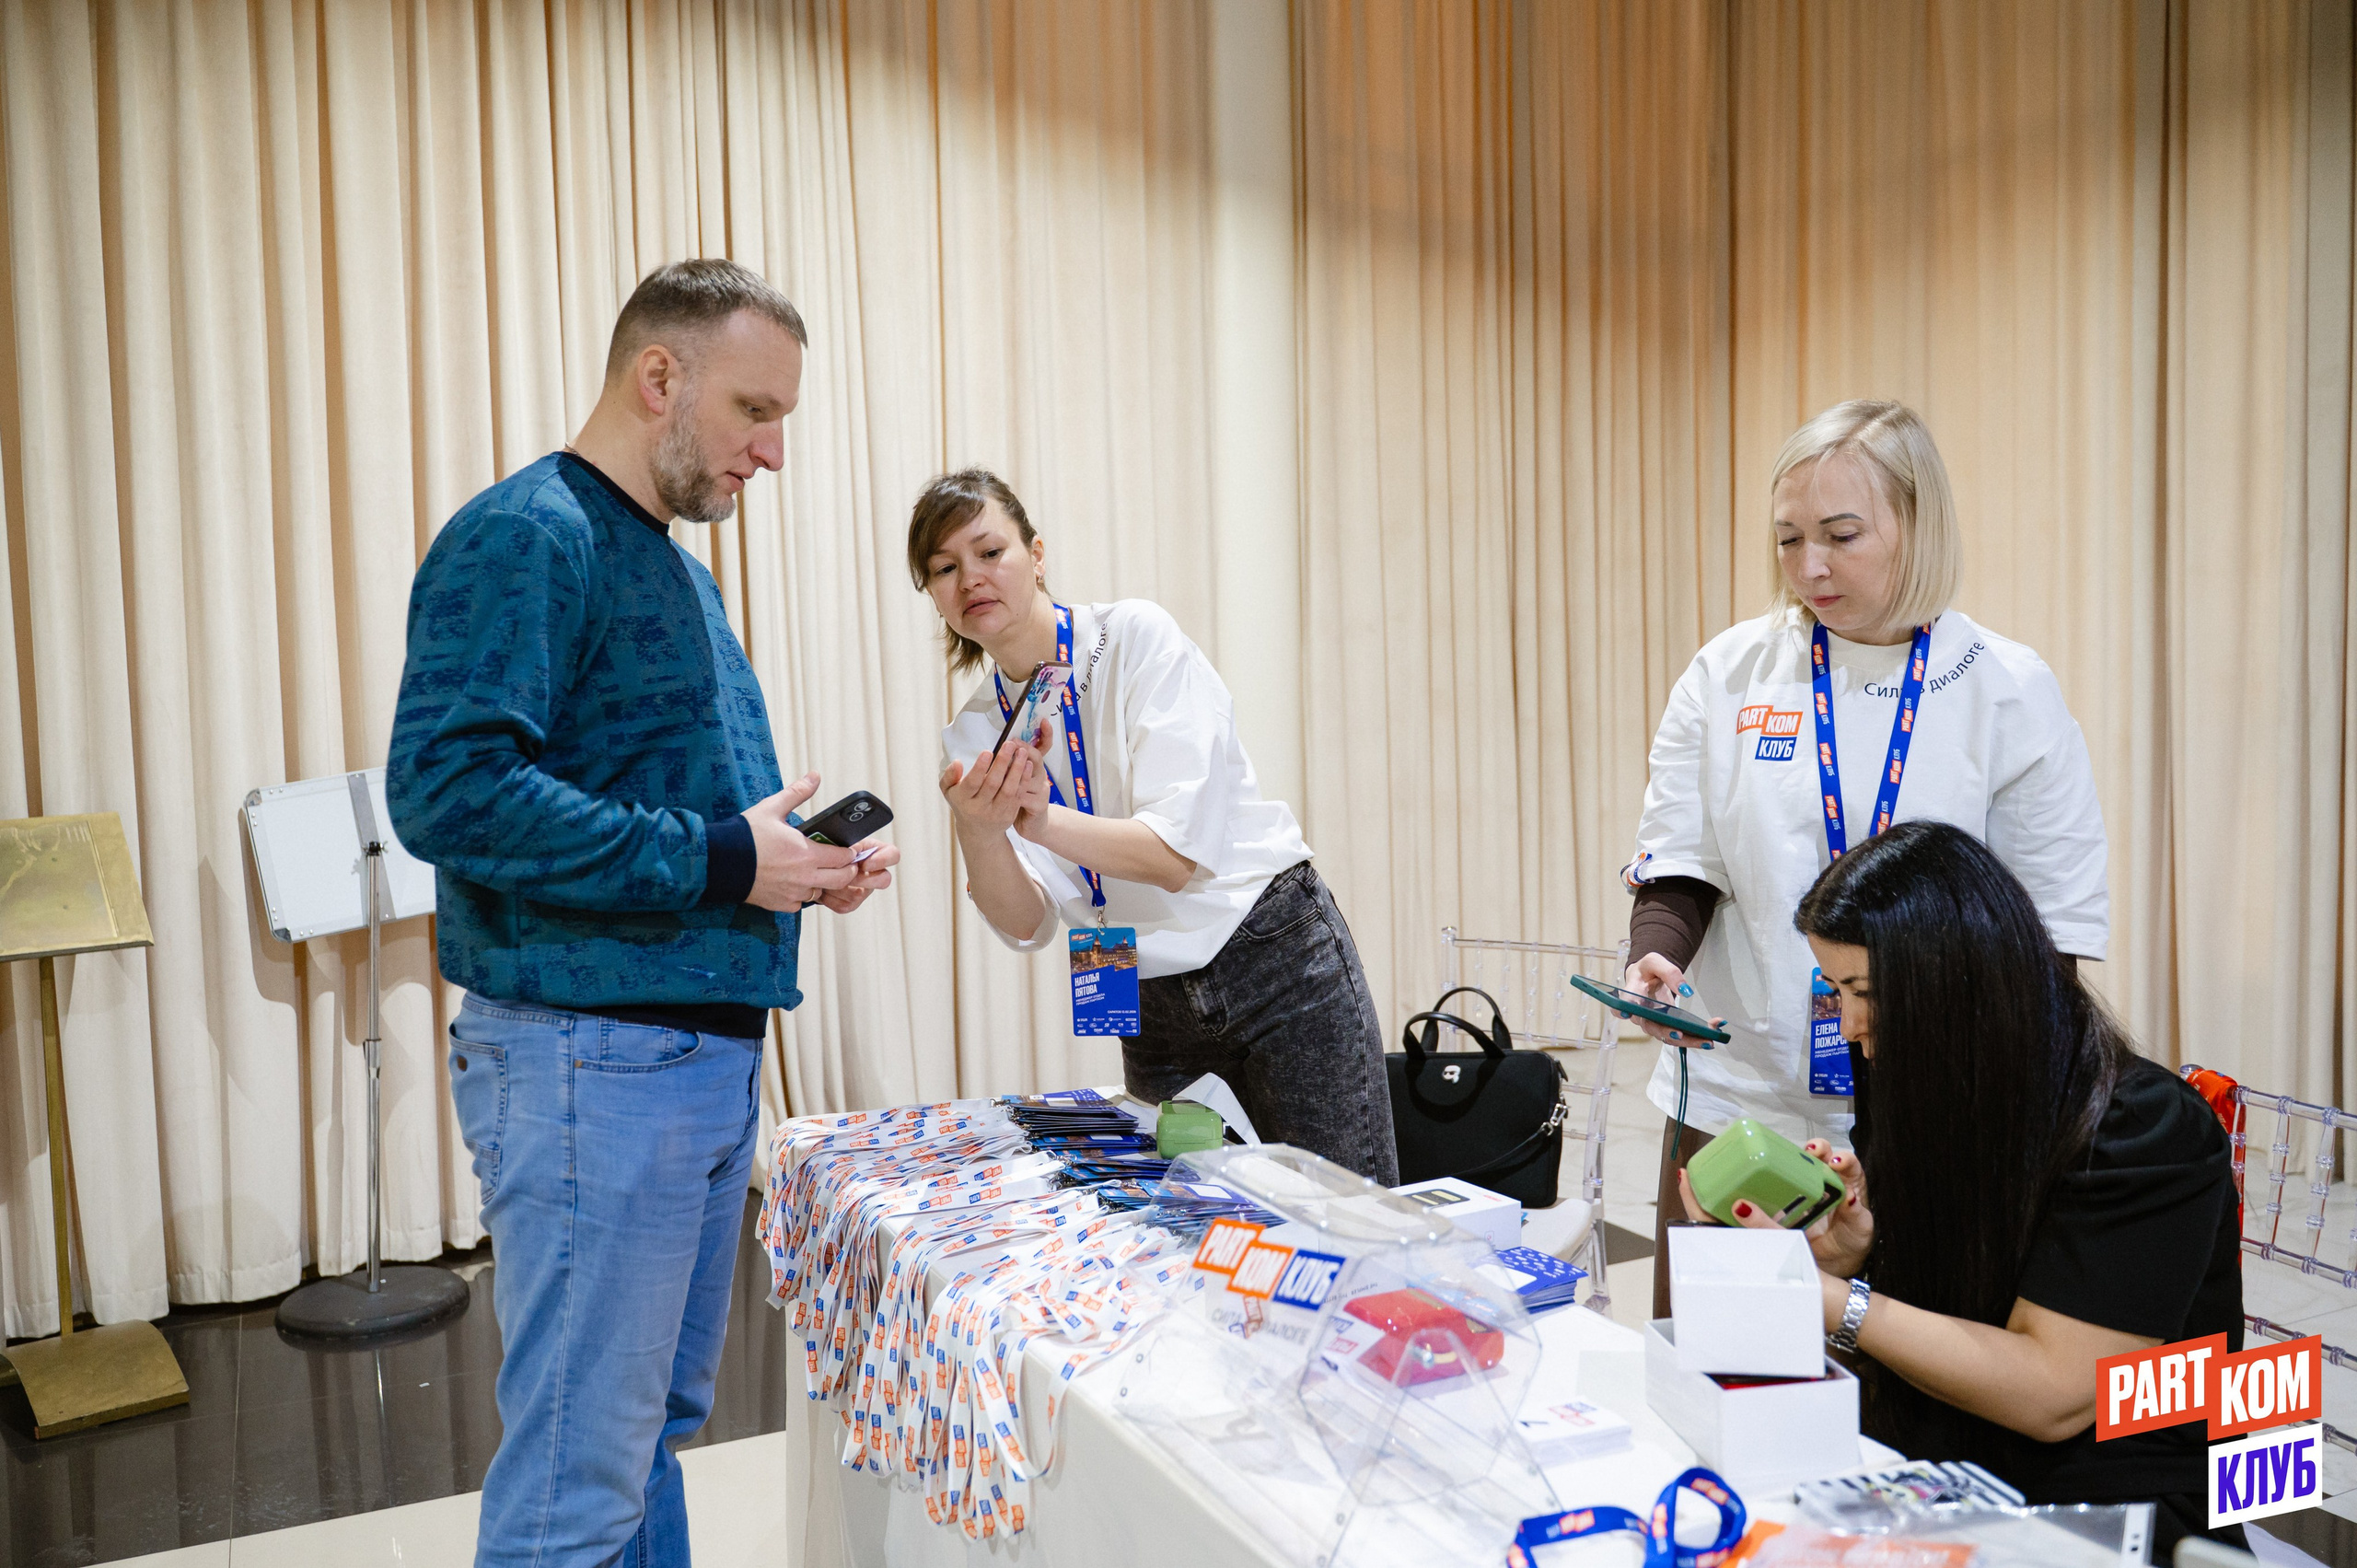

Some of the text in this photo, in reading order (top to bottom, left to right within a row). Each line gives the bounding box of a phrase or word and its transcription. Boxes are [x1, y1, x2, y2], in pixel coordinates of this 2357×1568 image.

[1864, 682, 1902, 698] Сил
[1929, 642, 1985, 693] диалоге
[1738, 707, 1799, 733] PART KOM
[1759, 739, 1794, 758] КЛУБ
[1074, 972, 1099, 986] НАТАЛЬЯ
[1816, 1022, 1838, 1036] ЕЛЕНА
[1198, 1224, 1257, 1270] PART
[1232, 1247, 1289, 1295] KOM
[1277, 1255, 1341, 1305] КЛУБ
